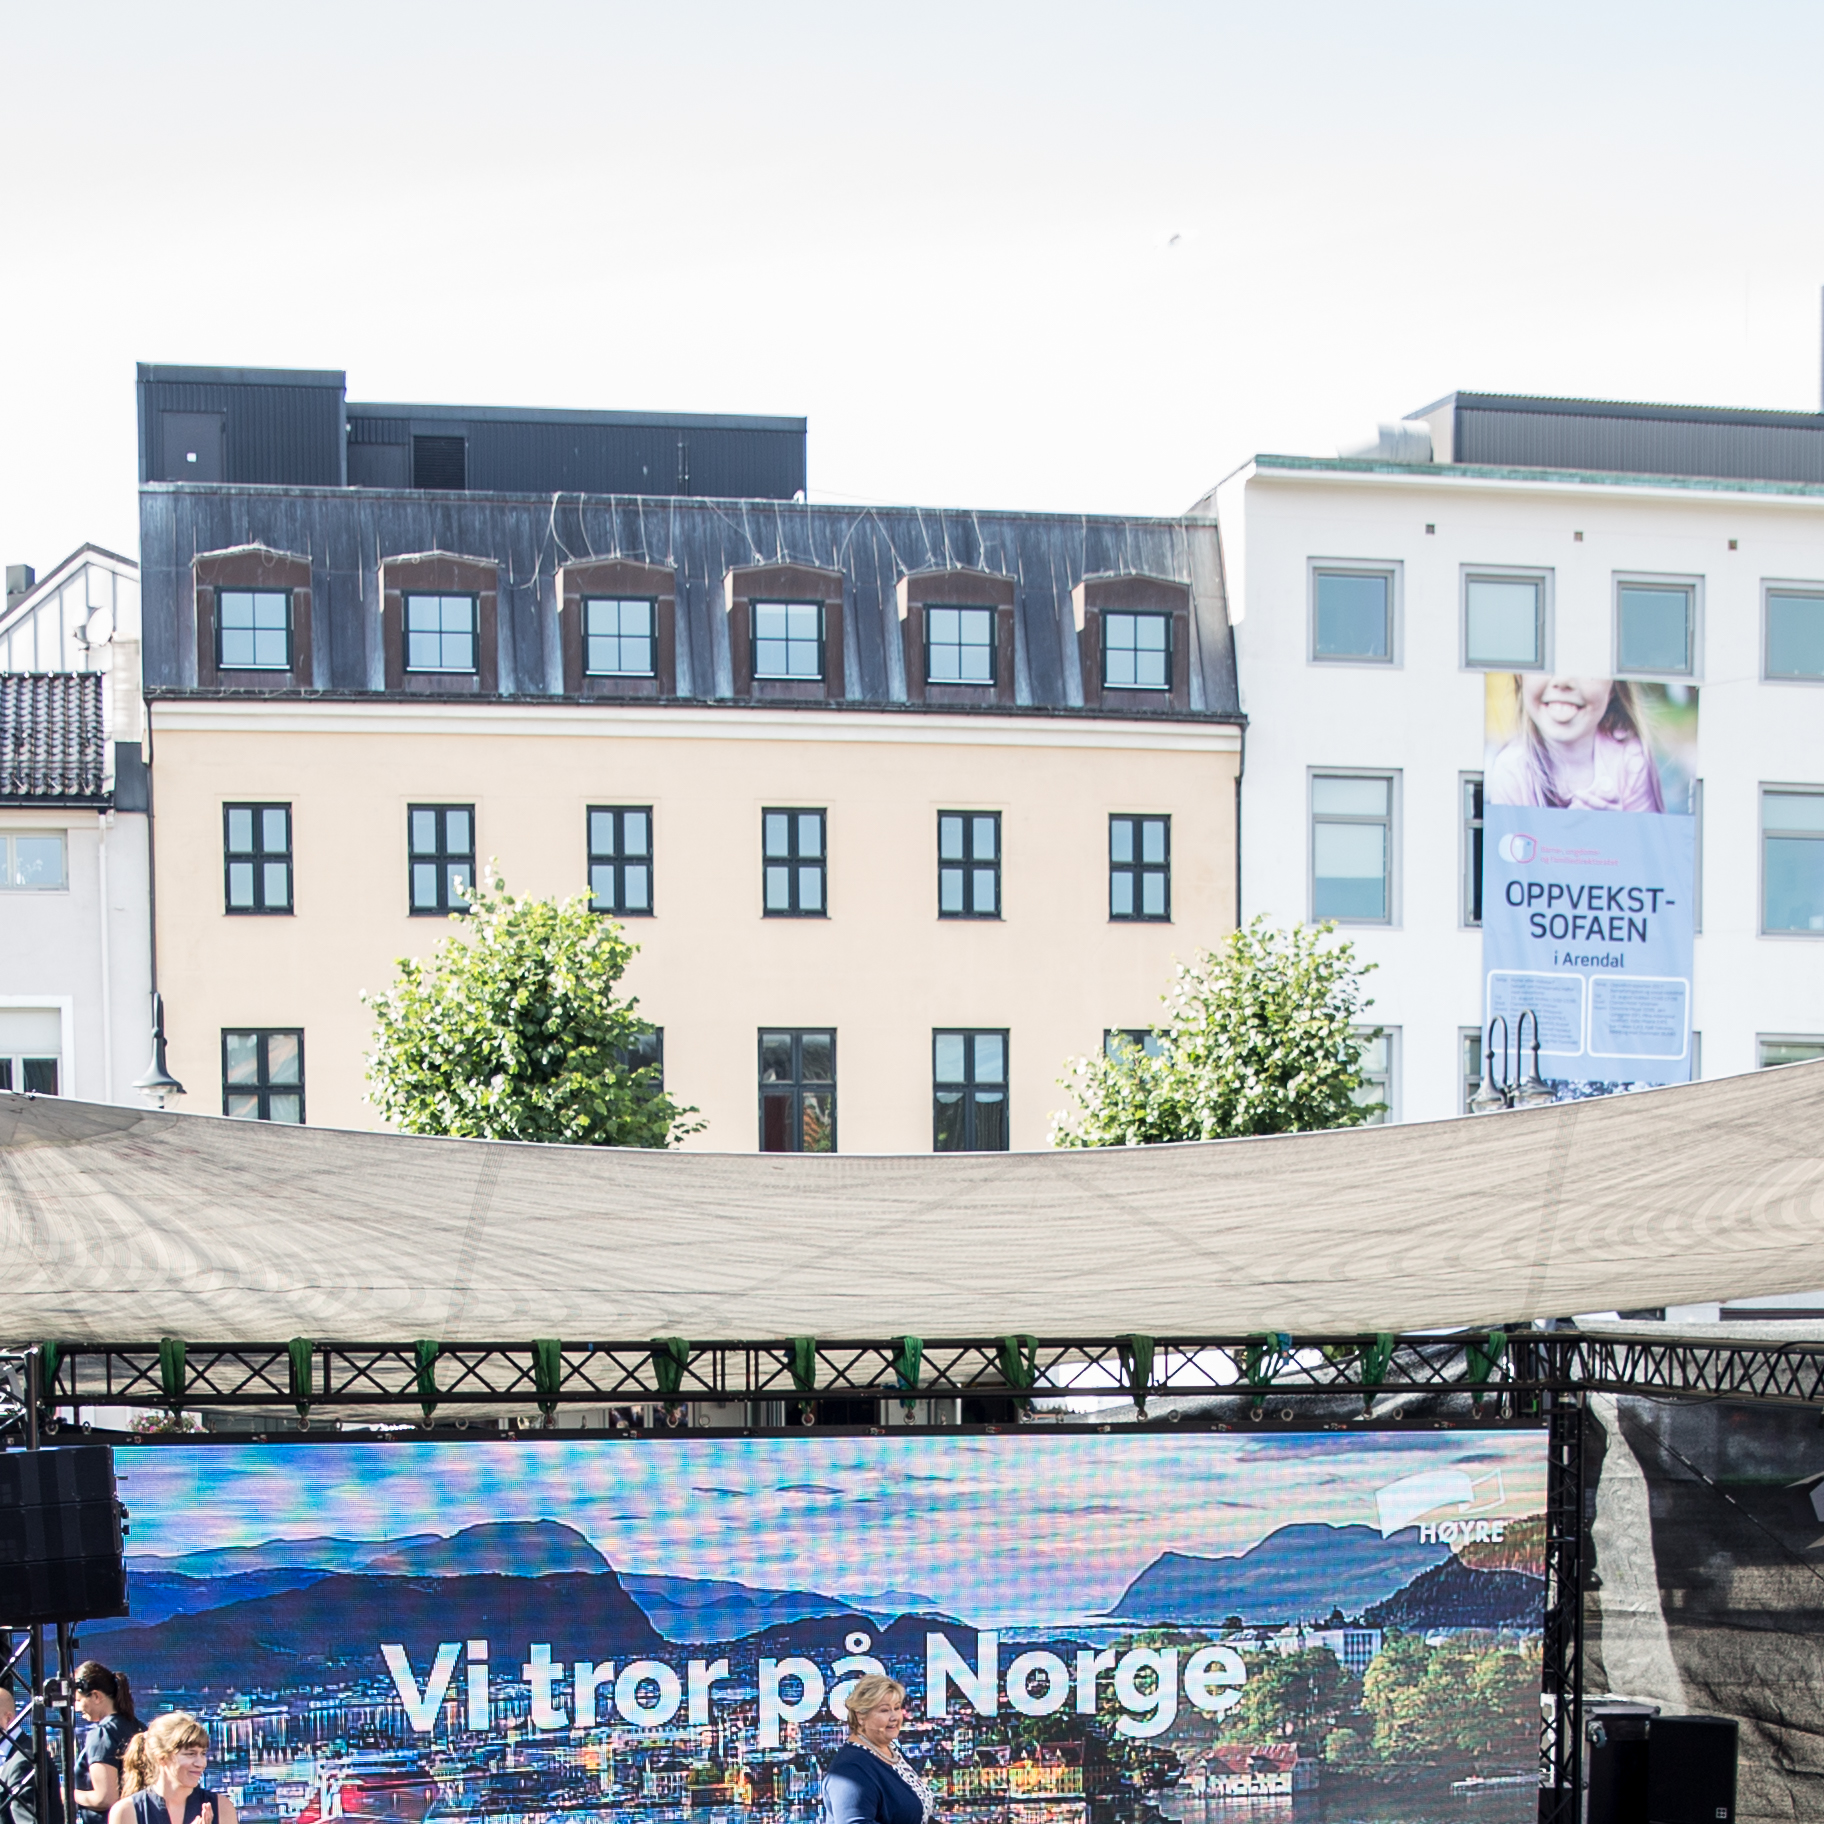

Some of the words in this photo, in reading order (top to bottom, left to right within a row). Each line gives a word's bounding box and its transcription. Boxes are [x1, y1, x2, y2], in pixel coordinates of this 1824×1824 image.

[1505, 880, 1675, 914] OPPVEKST-
[1530, 912, 1647, 943] SOFAEN
[1554, 951, 1558, 966] i
[1562, 952, 1624, 968] Arendal
[1420, 1519, 1504, 1544] HØYRE
[380, 1639, 490, 1732] Vi
[522, 1642, 730, 1730] tror
[758, 1631, 887, 1748] på
[925, 1631, 1248, 1739] Norge
